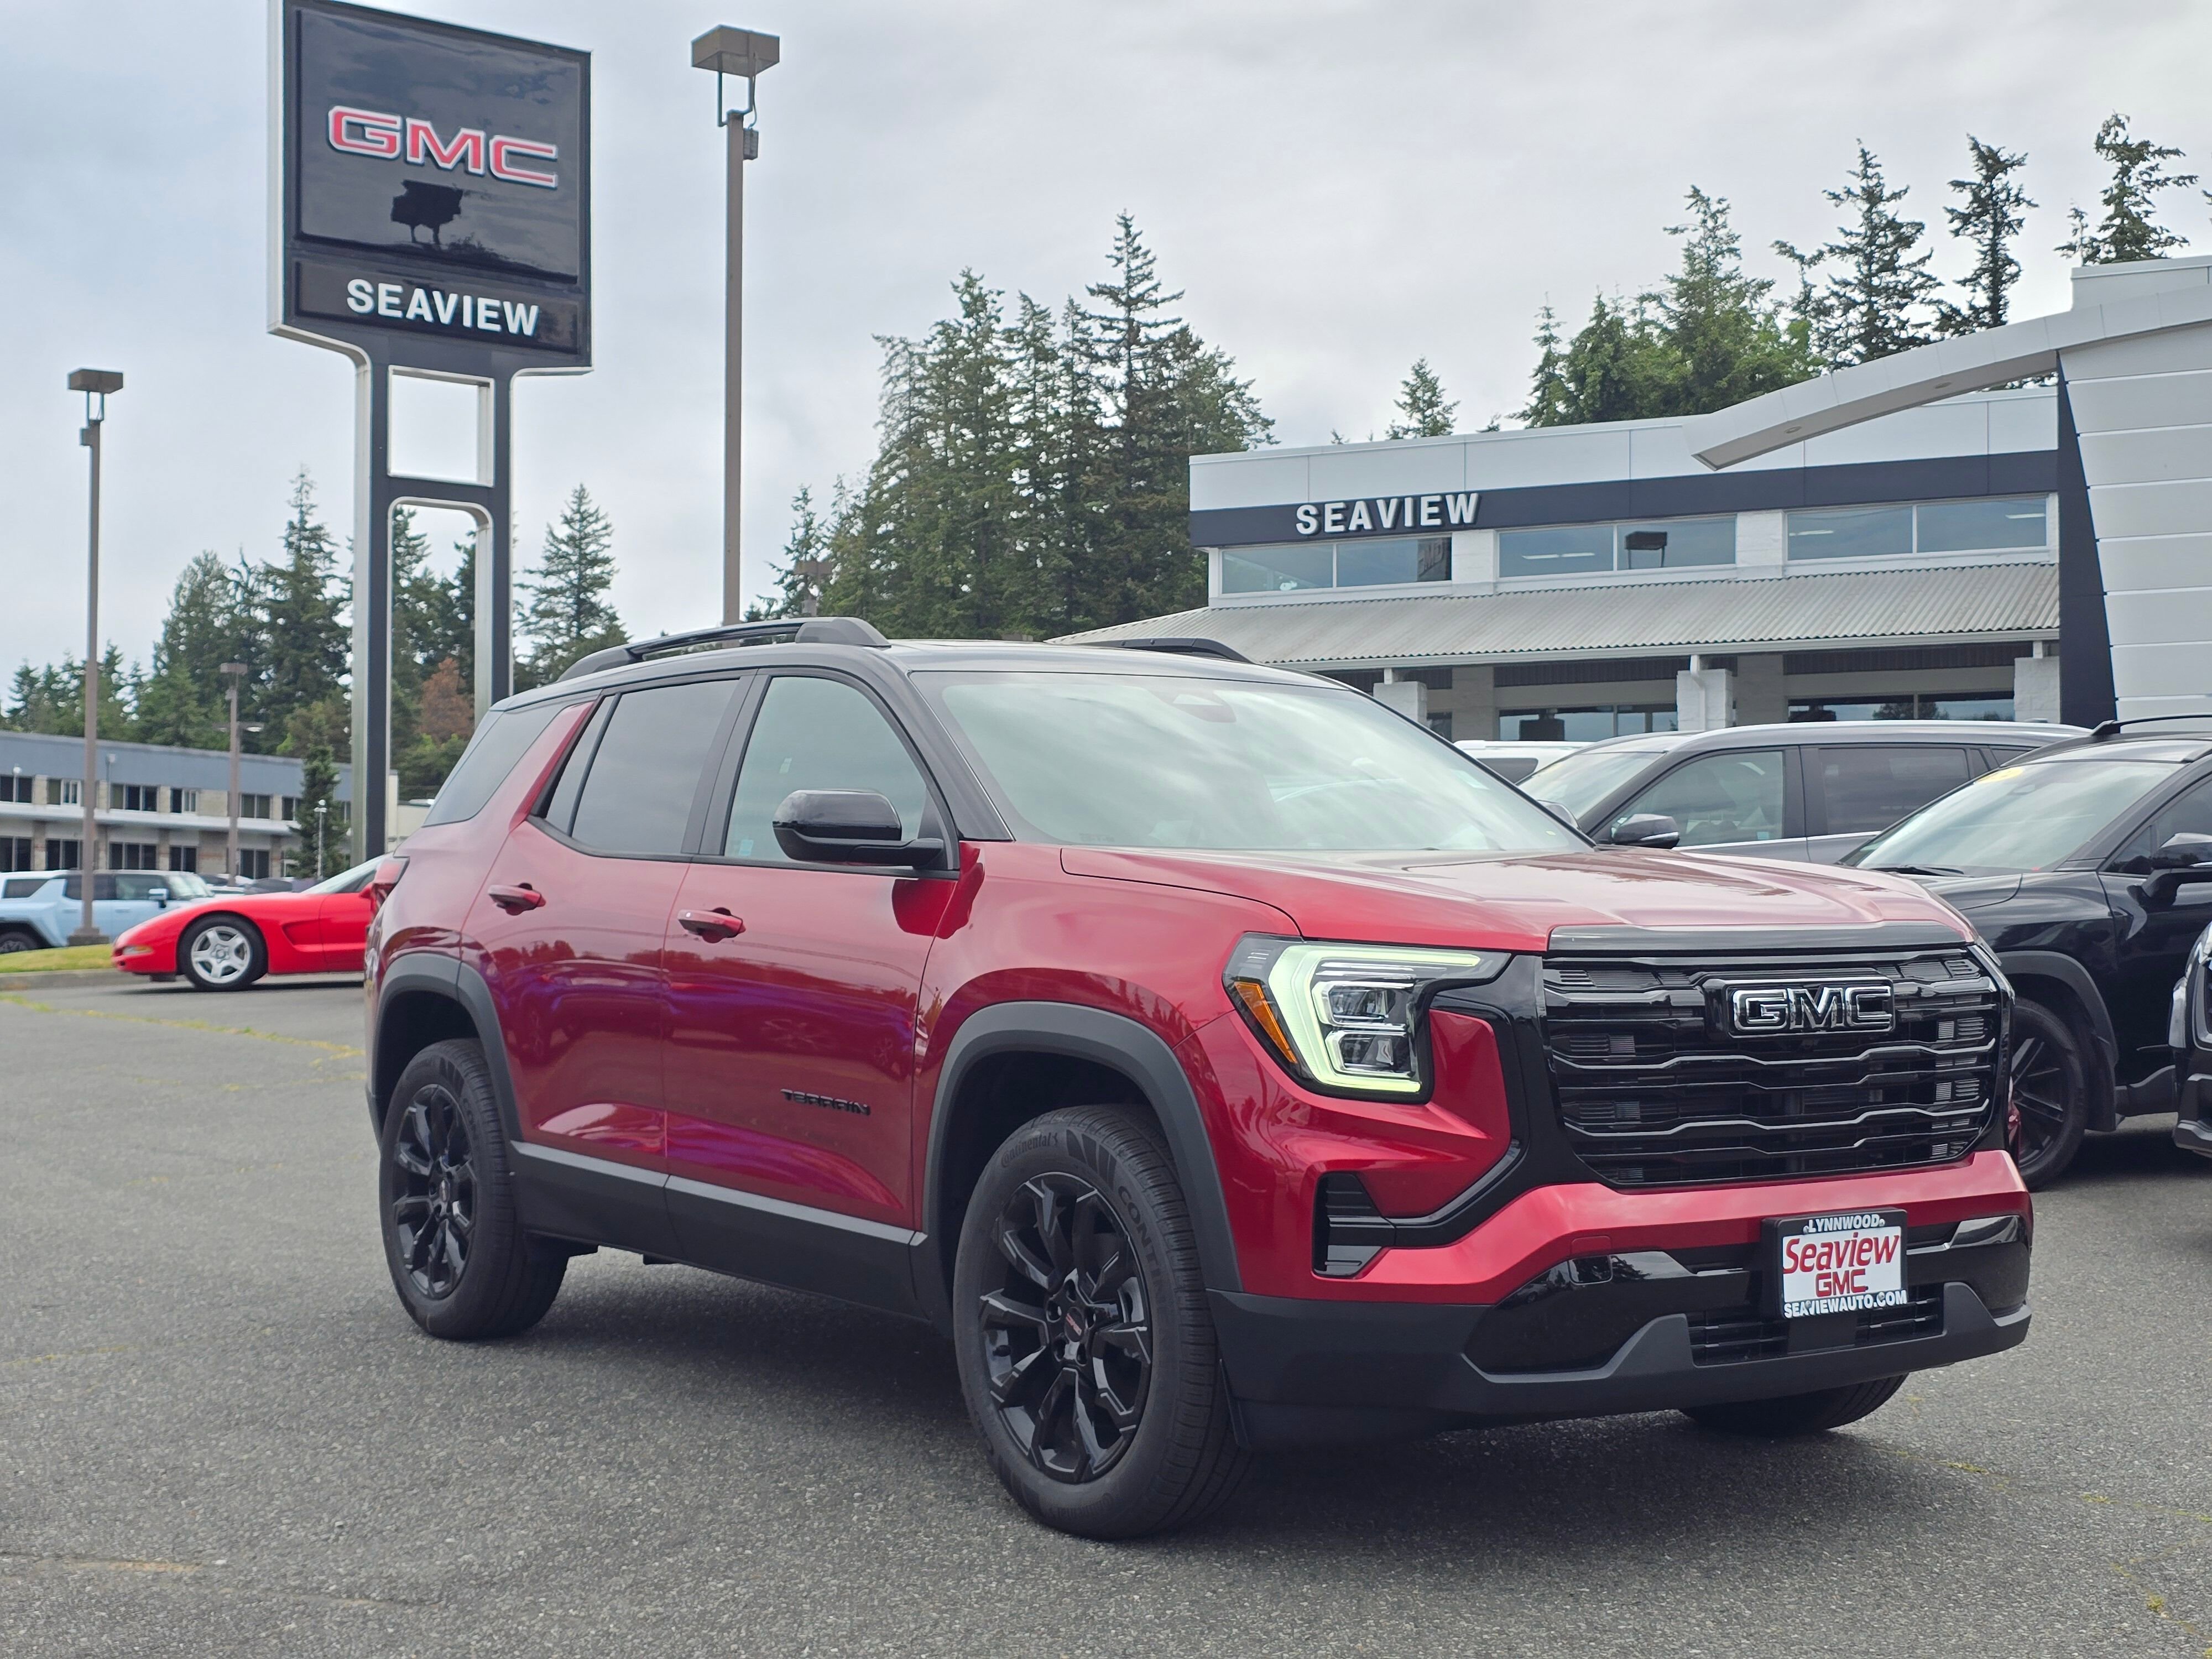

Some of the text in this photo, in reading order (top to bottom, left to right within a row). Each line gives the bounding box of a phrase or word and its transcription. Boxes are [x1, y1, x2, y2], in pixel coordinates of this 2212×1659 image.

[328, 106, 557, 189] GMC
[347, 279, 539, 336] SEAVIEW
[1296, 492, 1480, 535] SEAVIEW
[1733, 986, 1892, 1030] GMC
[780, 1088, 870, 1116] TERRAIN
[1808, 1214, 1880, 1233] LYNNWOOD
[1783, 1232, 1900, 1274] Seaview
[1815, 1268, 1868, 1297] GMC
[1784, 1290, 1907, 1318] SEAVIEWAUTO.COM
